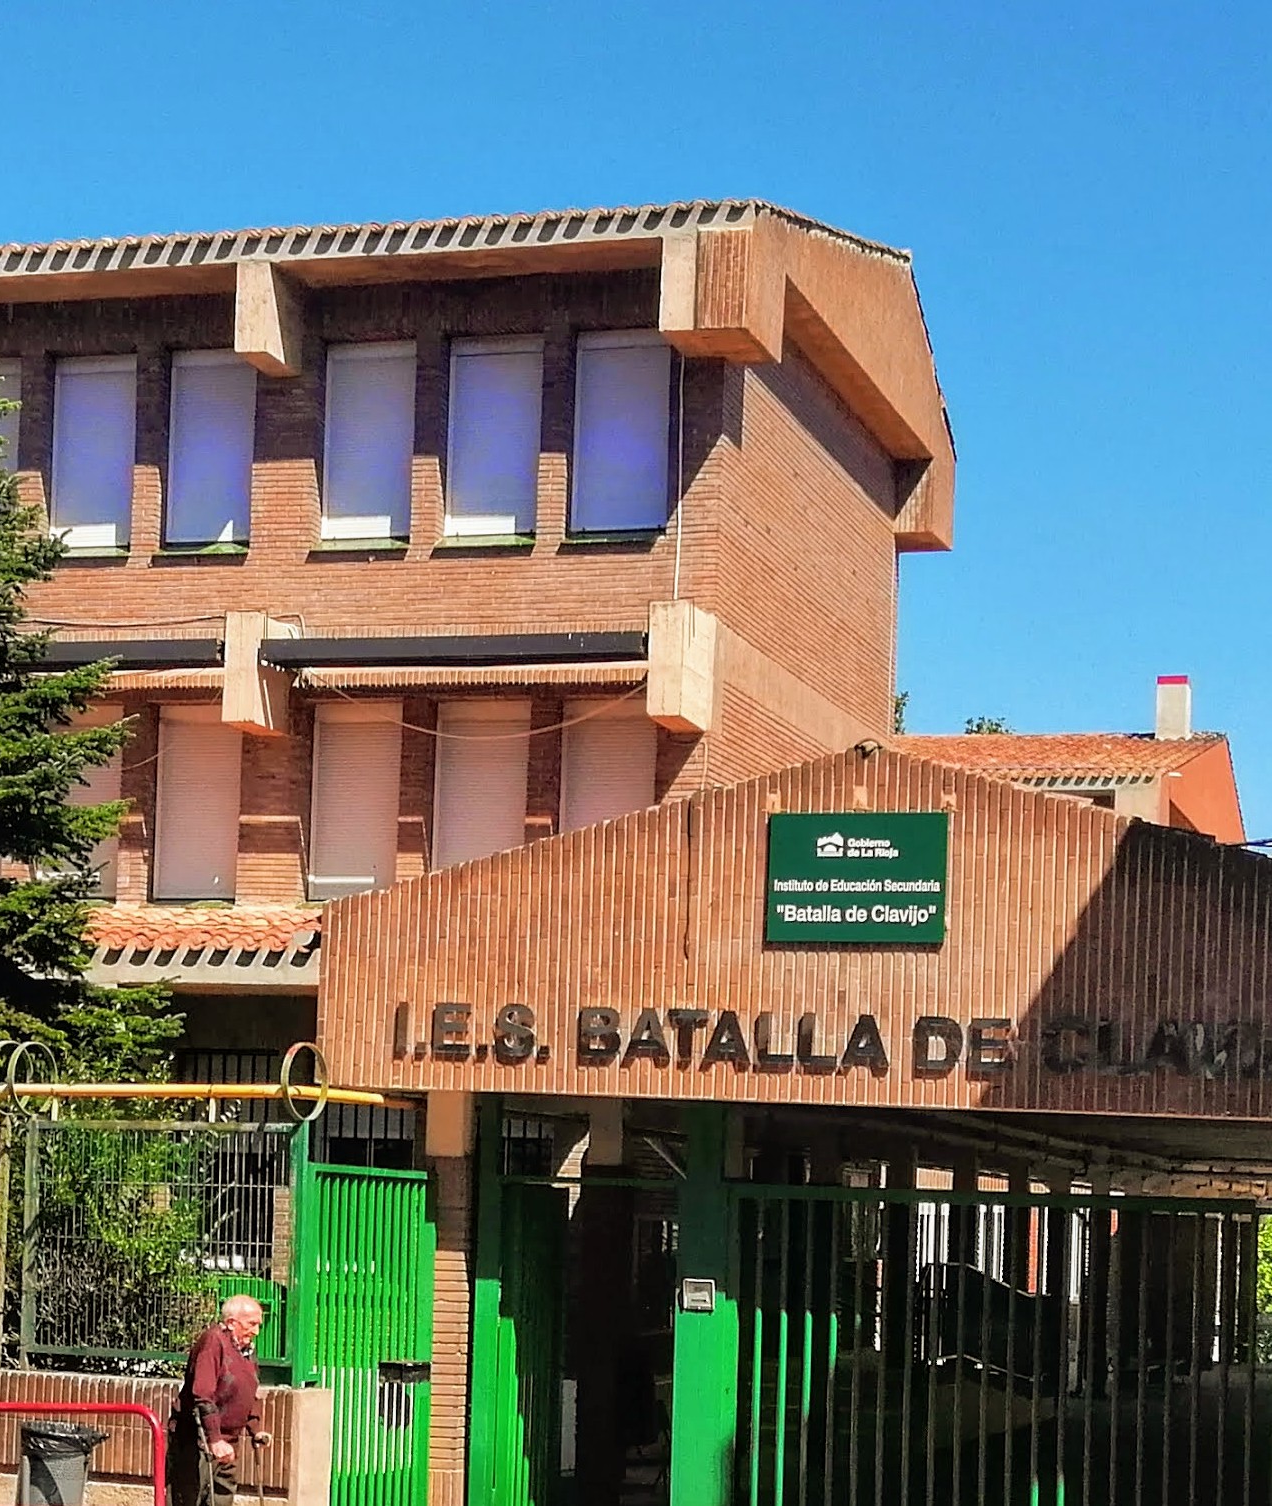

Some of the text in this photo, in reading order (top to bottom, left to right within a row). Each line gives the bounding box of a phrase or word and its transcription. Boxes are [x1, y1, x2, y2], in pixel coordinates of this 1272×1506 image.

[847, 838, 890, 848] Gobierno
[847, 848, 899, 859] de La Rioja
[774, 879, 941, 892] Instituto de Educación Secundaria
[777, 904, 937, 927] "Batalla de Clavijo"
[393, 1002, 552, 1064] I.E.S.
[575, 1006, 890, 1077] BATALLA
[912, 1015, 1015, 1077] DE
